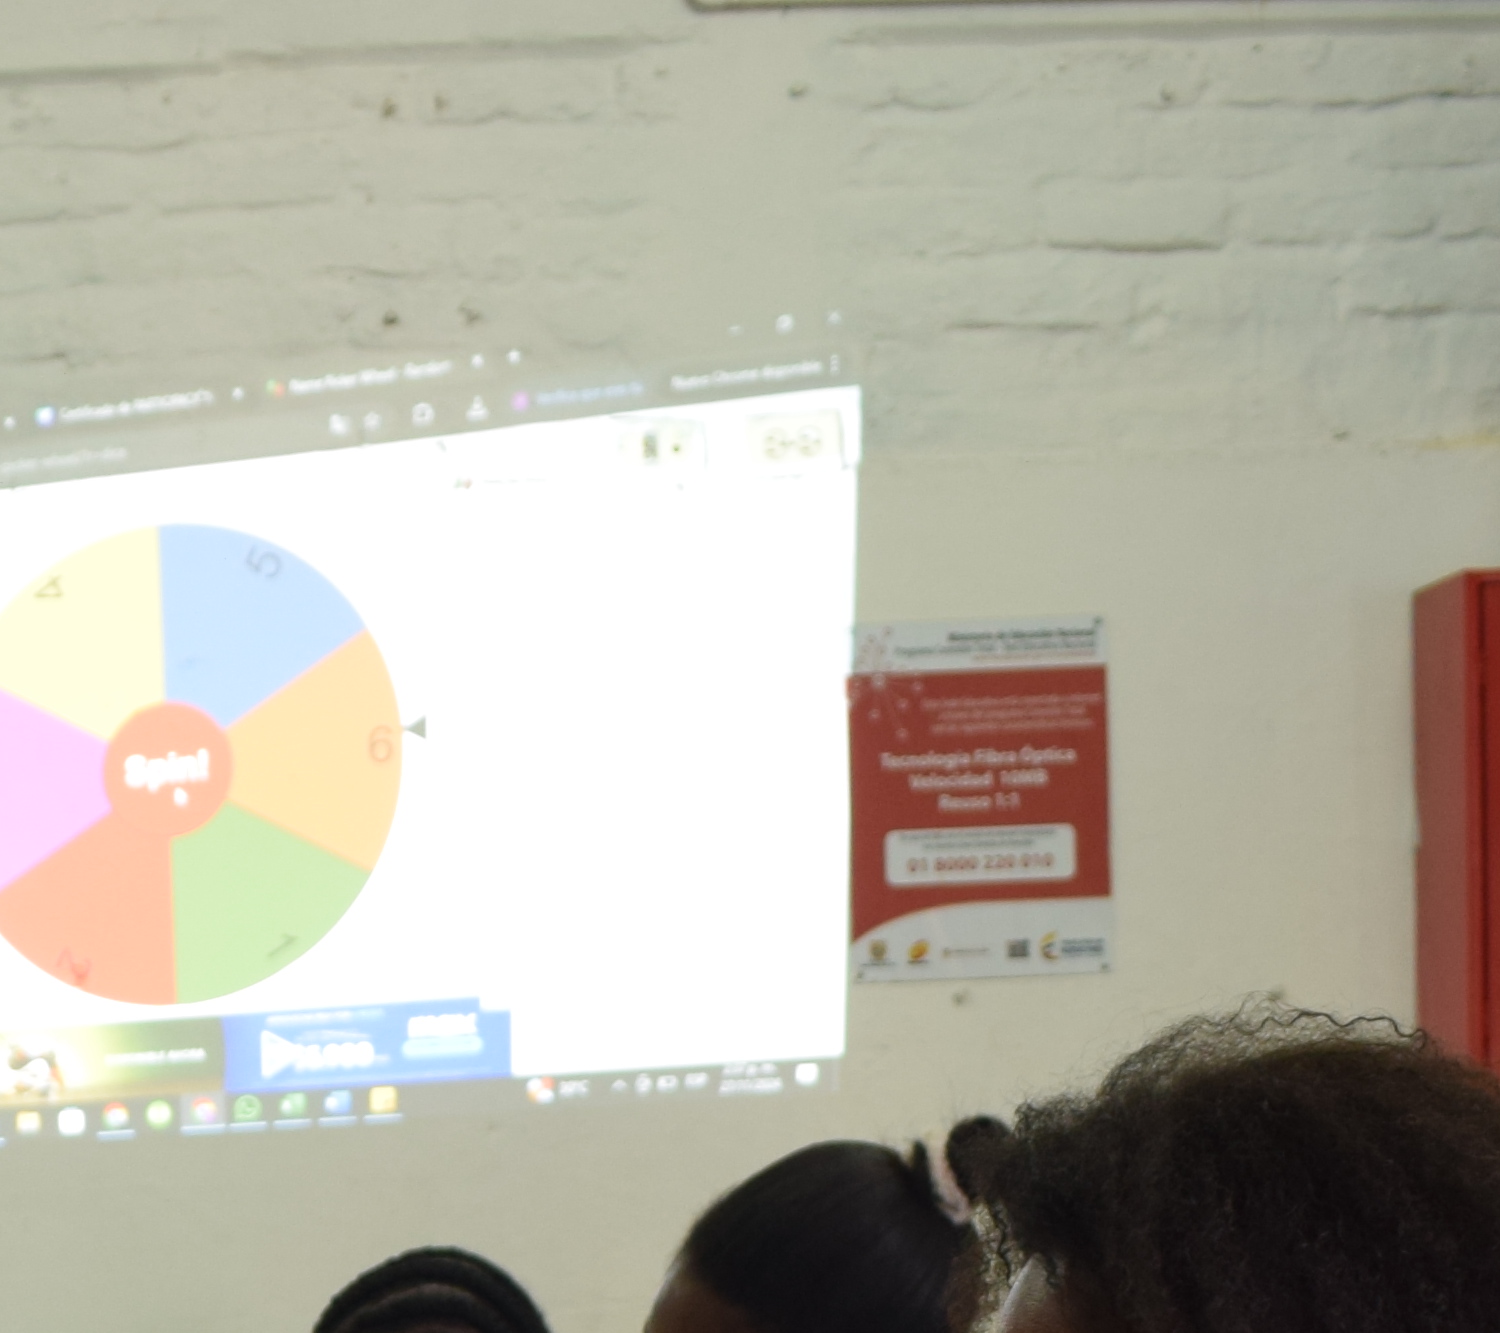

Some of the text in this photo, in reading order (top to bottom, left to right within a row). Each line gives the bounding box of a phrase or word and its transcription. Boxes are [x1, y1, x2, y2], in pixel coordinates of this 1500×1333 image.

[246, 545, 282, 580] 5
[34, 575, 63, 599] 4
[368, 724, 393, 762] 6
[124, 748, 209, 793] Spin!
[268, 933, 298, 958] 1
[56, 947, 92, 987] 2
